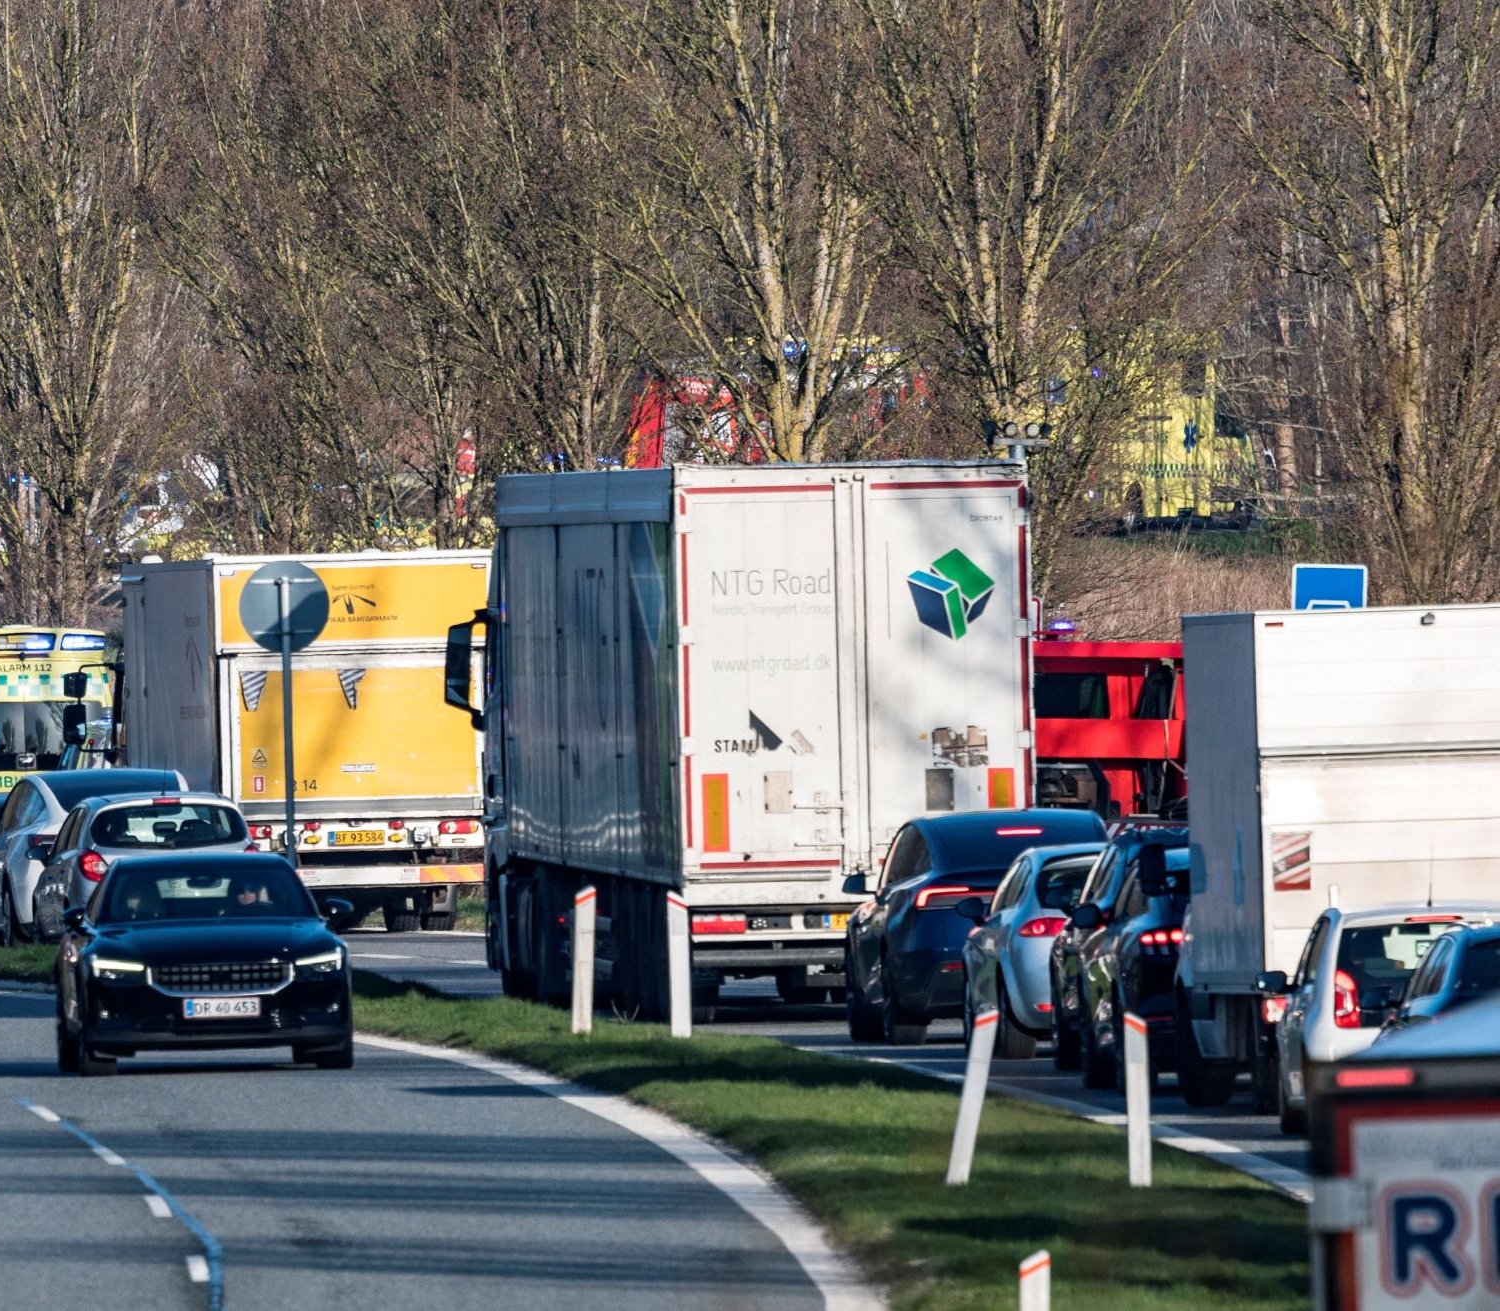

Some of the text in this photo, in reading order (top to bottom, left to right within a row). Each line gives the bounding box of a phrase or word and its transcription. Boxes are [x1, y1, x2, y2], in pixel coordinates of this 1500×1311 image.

[710, 567, 831, 597] NTG Road
[711, 602, 833, 618] Nordic Transport Group
[34, 663, 53, 672] 112
[711, 653, 832, 678] www.ntgroad.dk
[303, 779, 318, 792] 14
[335, 833, 348, 843] BF
[350, 832, 364, 842] 93
[215, 1002, 231, 1014] 40
[234, 1001, 258, 1013] 453
